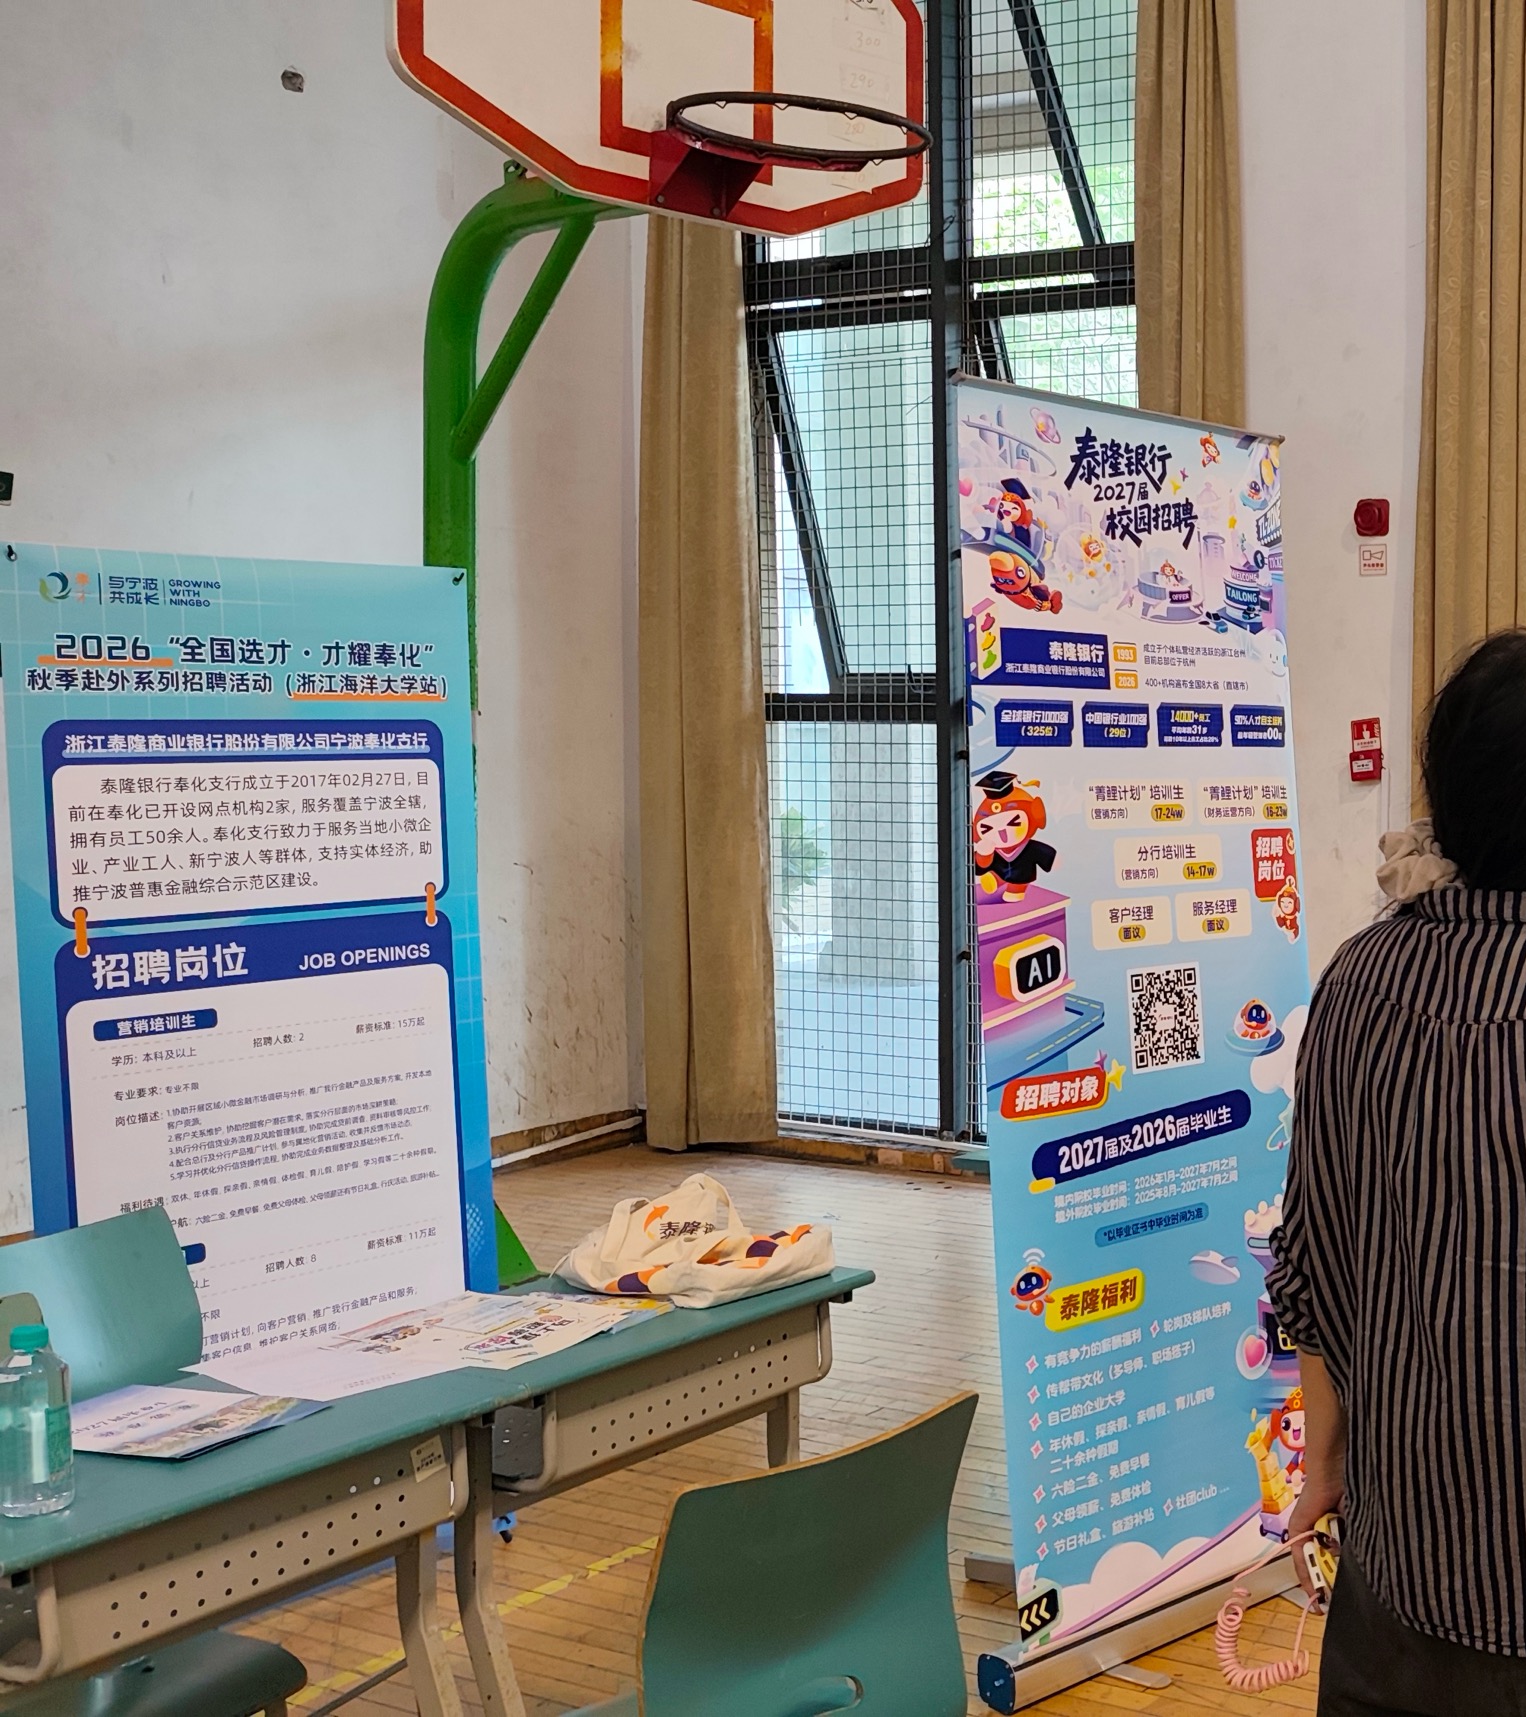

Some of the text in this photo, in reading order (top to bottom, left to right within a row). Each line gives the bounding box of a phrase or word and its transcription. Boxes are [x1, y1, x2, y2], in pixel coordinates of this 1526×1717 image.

[1064, 427, 1172, 494] 泰隆银行
[1093, 482, 1149, 502] 2027届
[1105, 497, 1198, 549] 校园招聘
[108, 575, 158, 592] 与宁波
[168, 579, 221, 590] GROWING
[169, 589, 200, 598] WITH
[109, 591, 160, 606] 共成长
[169, 598, 211, 608] NINGBO
[1226, 587, 1258, 603] TAILONG
[1049, 641, 1105, 663] 泰隆银行
[64, 733, 429, 755] 浙江泰隆商业银行股份有限公司宁波奉化支行
[1137, 843, 1197, 862] 分行培训生
[1255, 835, 1284, 858] 招聘
[1257, 859, 1286, 882] 岗位
[73, 873, 319, 902] 推宁波普惠金融综合示范区建设。
[1109, 905, 1155, 924] 客户经理
[1192, 898, 1238, 916] 服务经理
[1123, 925, 1142, 941] 面议
[1206, 918, 1225, 933] 面议
[92, 943, 431, 990] 招聘岗位 JOB OPENINGS
[1027, 953, 1052, 989] AI
[117, 1013, 196, 1037] 营销培训生
[1015, 1076, 1101, 1113] 招聘对象
[1058, 1103, 1233, 1175] 2027届及2026届毕业生
[1059, 1276, 1139, 1321] 泰隆福利
[1044, 1302, 1232, 1370] 有竞争力的薪酬福利 轮岗及梯队培养
[1047, 1389, 1127, 1427] 自己的企业大学
[1050, 1440, 1120, 1475] 二十余种假期
